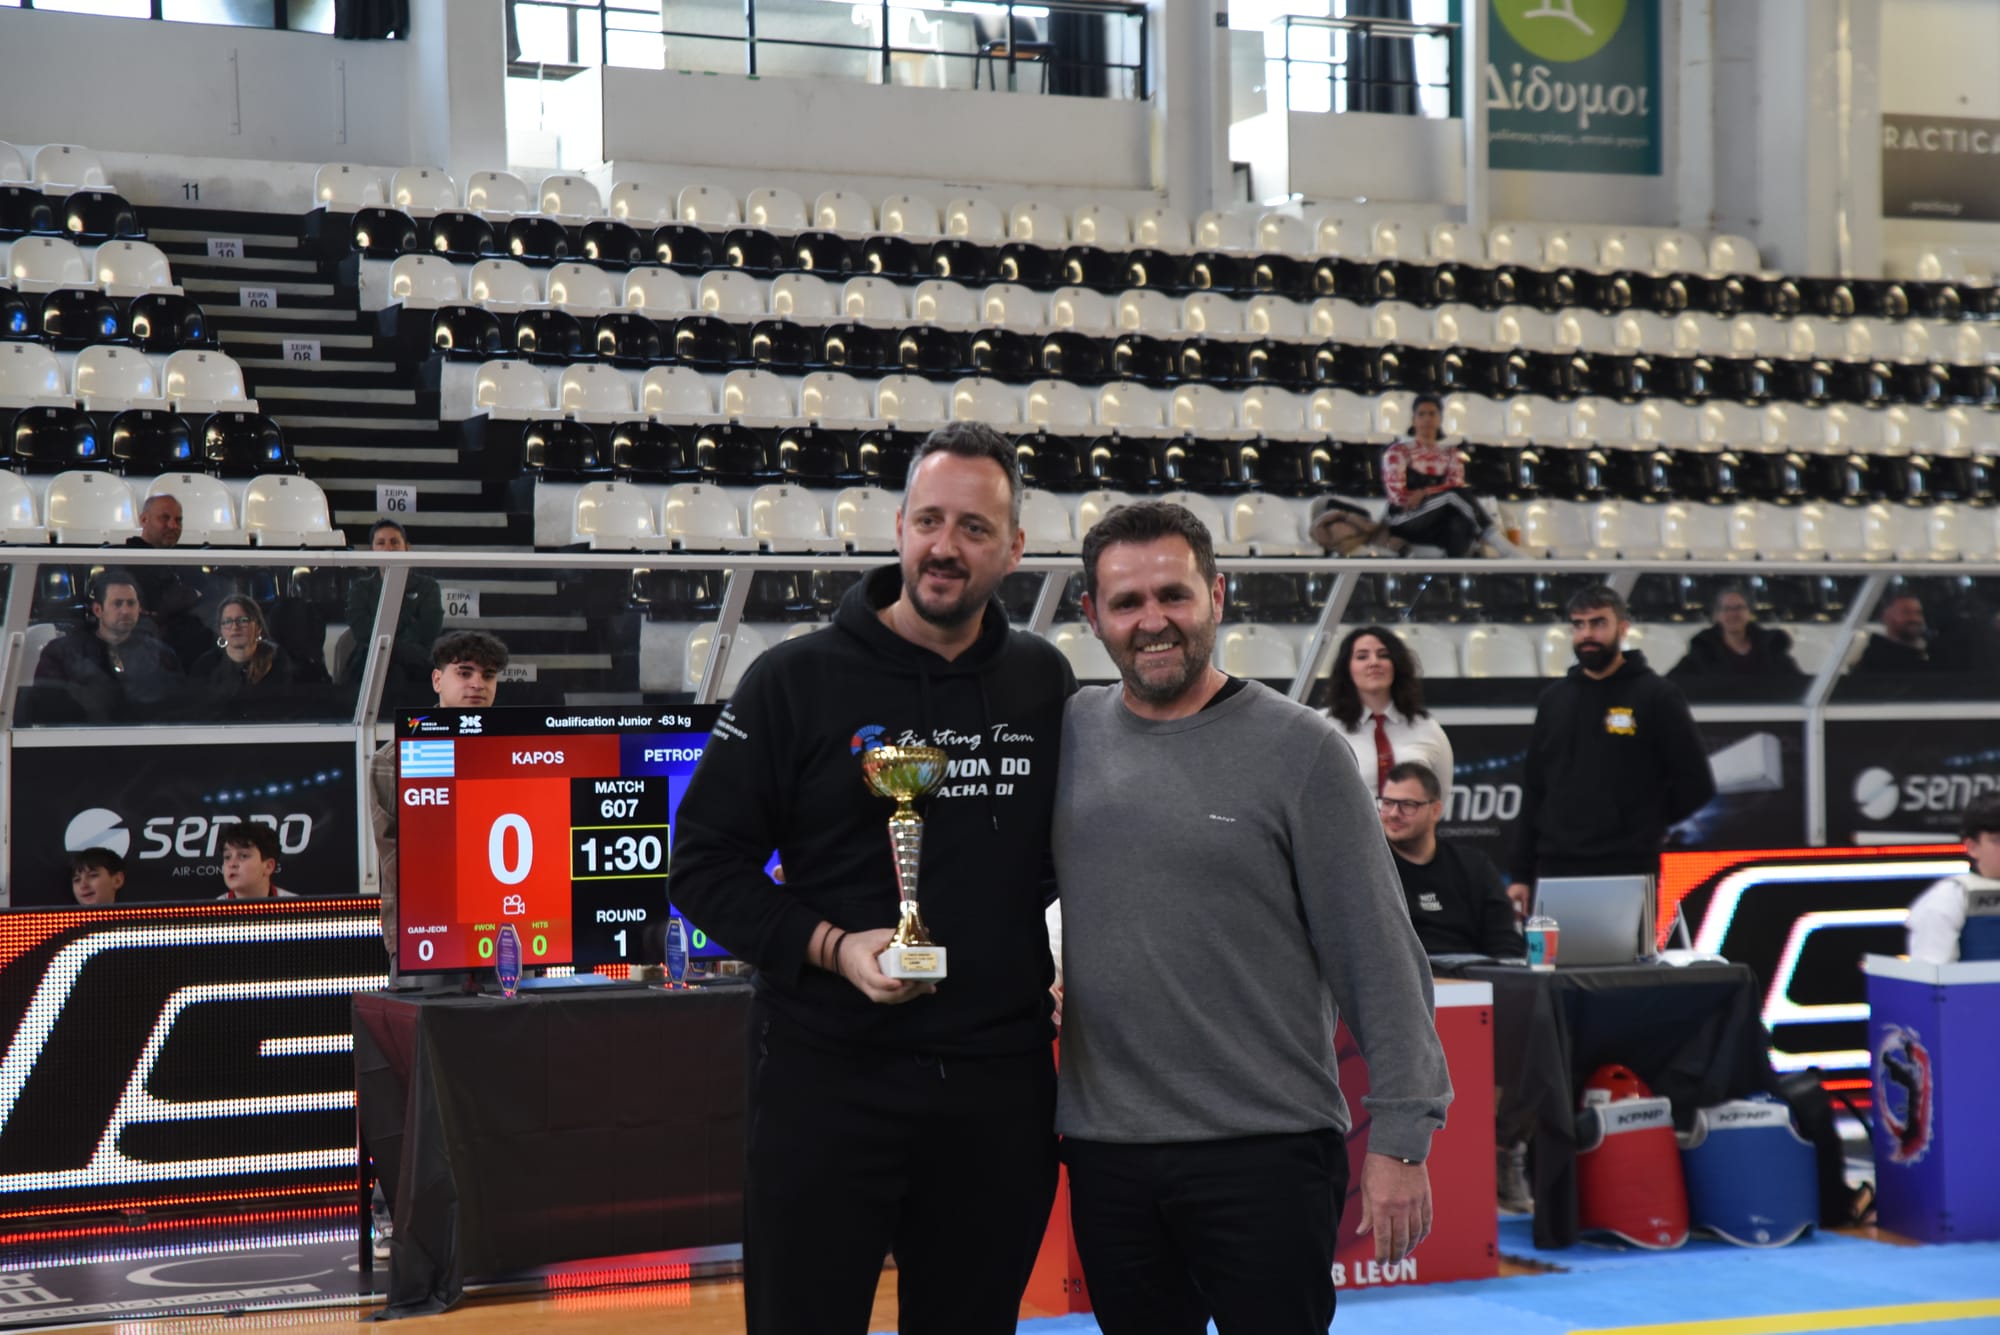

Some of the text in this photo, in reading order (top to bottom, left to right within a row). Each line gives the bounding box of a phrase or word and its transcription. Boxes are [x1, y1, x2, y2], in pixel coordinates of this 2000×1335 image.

[182, 183, 199, 200] 11
[387, 498, 406, 512] 06
[449, 602, 468, 617] 04
[545, 715, 691, 728] Qualification Junior -63 kg
[991, 723, 1035, 743] Team
[511, 751, 565, 765] KAPOS
[595, 781, 645, 794] MATCH
[404, 788, 449, 806] GRE
[601, 799, 639, 818] 607
[488, 813, 534, 885] 0
[580, 835, 662, 871] 1:30
[532, 921, 549, 929] HITS
[596, 909, 647, 923] ROUND
[408, 926, 448, 934] GAM-JEOM
[692, 928, 707, 949] 0
[418, 939, 434, 961] 0
[478, 937, 494, 958] 0
[532, 935, 547, 956] 0
[614, 929, 627, 957] 1
[1617, 1108, 1664, 1125] KPNP
[1354, 1258, 1417, 1285] LEON
